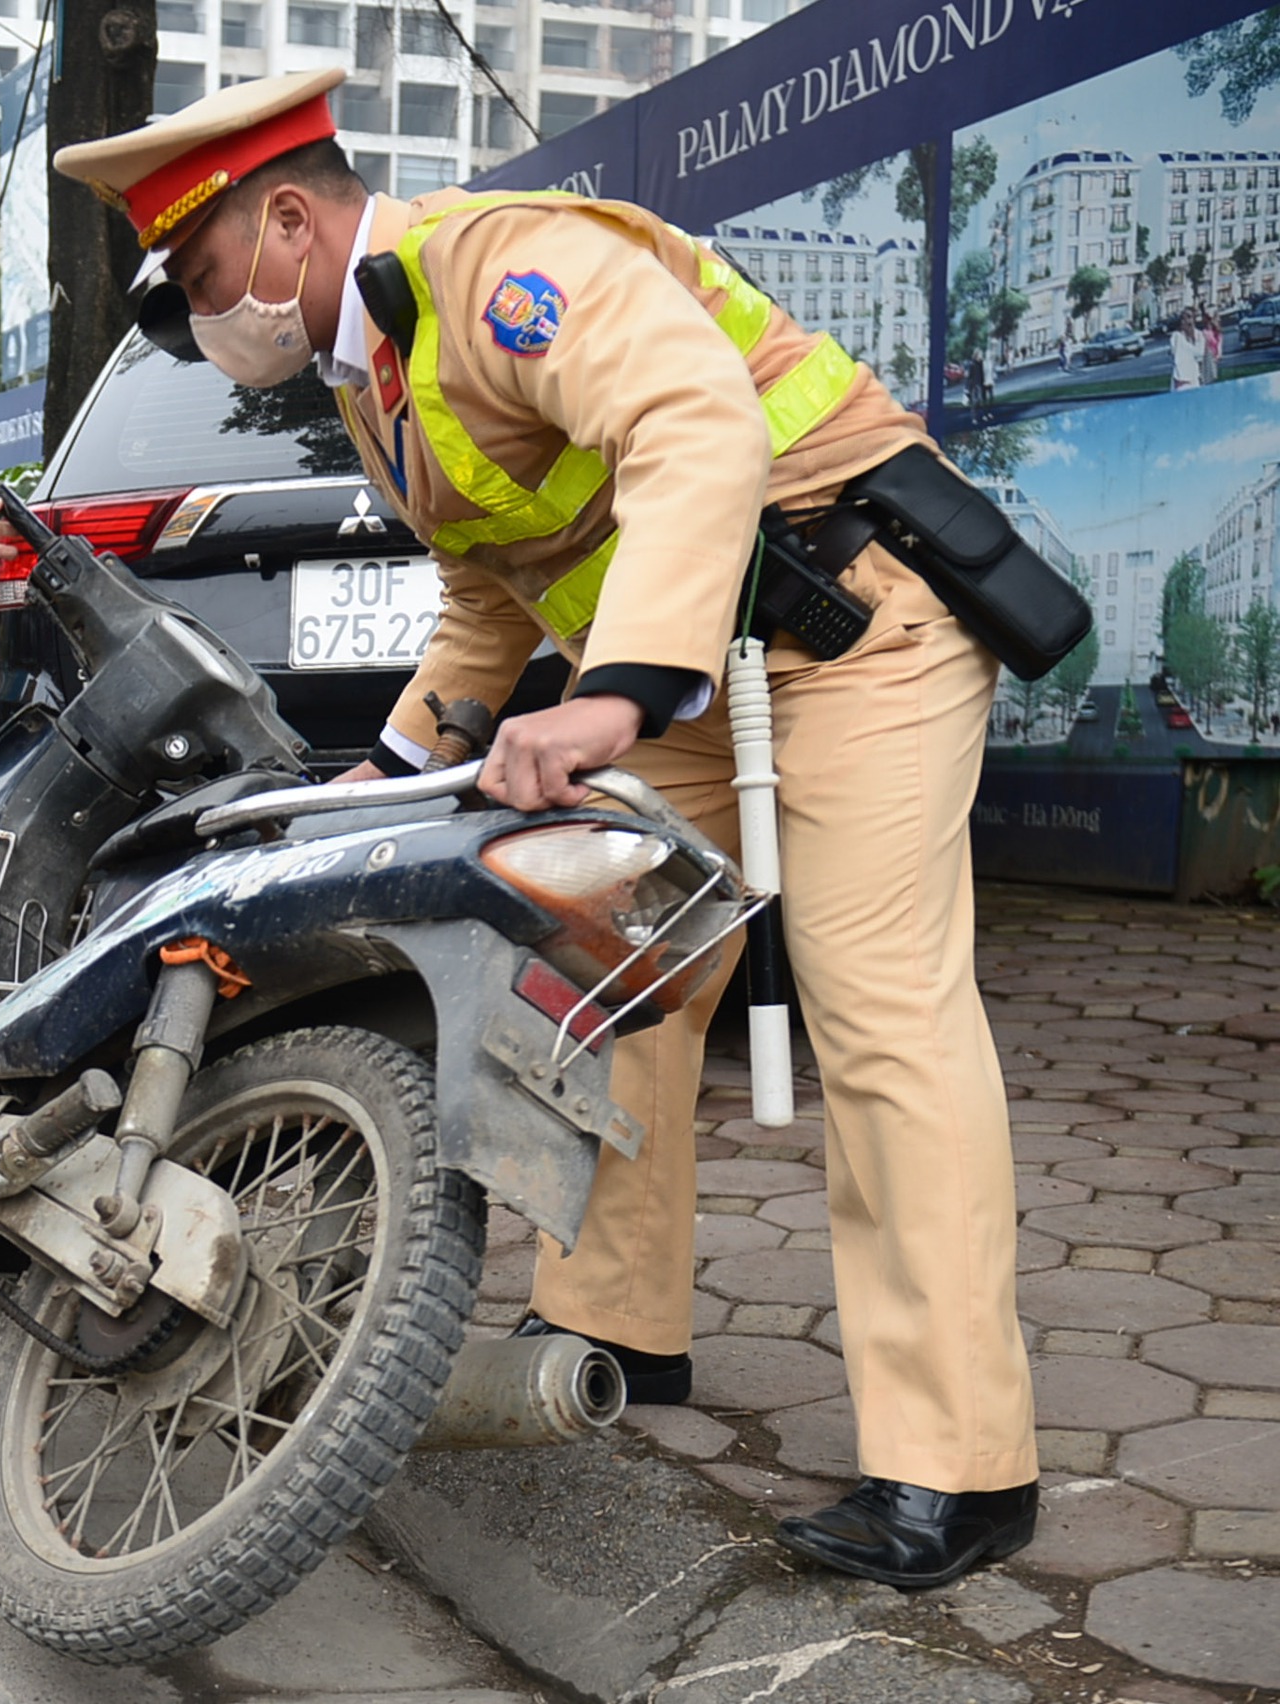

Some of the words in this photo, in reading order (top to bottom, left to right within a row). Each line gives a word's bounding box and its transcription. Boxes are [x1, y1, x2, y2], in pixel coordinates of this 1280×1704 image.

[677, 77, 797, 179] PALMY
[800, 0, 1014, 124] DIAMOND
[330, 559, 411, 608] 30F
[296, 610, 441, 661] 675.22
[1023, 802, 1047, 828] Hà
